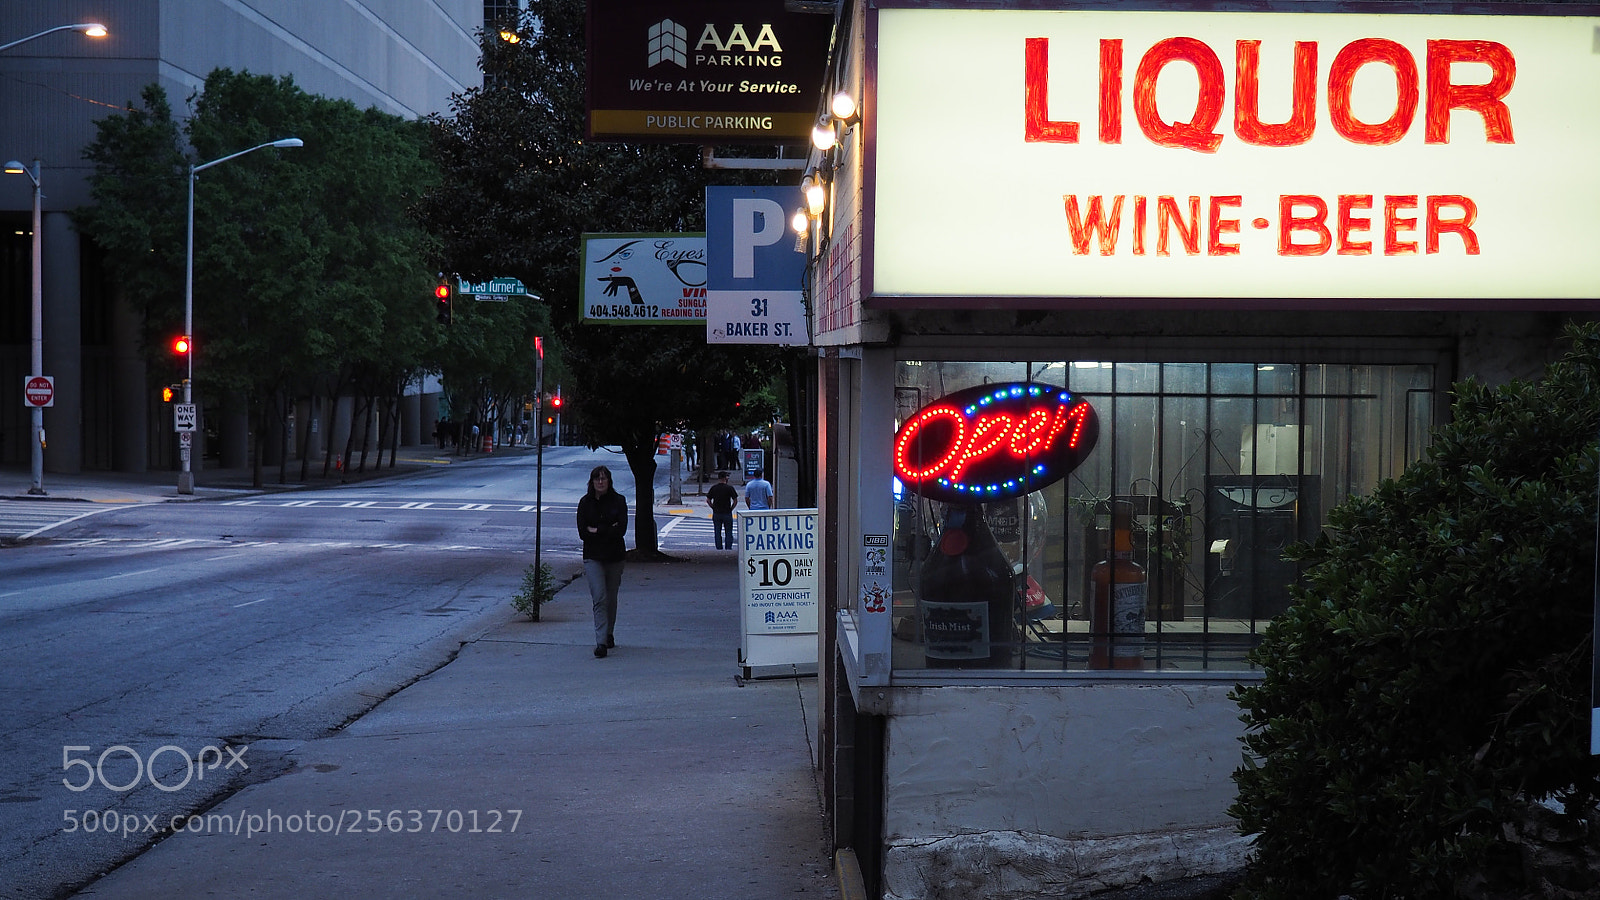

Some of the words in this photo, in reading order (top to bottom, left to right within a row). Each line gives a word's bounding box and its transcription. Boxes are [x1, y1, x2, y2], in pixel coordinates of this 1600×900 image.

[695, 23, 783, 52] AAA
[695, 55, 783, 67] PARKING
[629, 78, 673, 92] We're
[677, 79, 695, 92] At
[699, 80, 734, 93] Your
[738, 80, 802, 94] Service.
[1024, 36, 1517, 154] LIQUOR
[646, 115, 701, 129] PUBLIC
[705, 116, 773, 130] PARKING
[733, 198, 785, 278] P
[653, 240, 704, 266] Eyes
[489, 280, 516, 293] Turner
[589, 304, 658, 318] 404.548.4612
[661, 308, 692, 318] READING
[751, 299, 768, 317] 31
[726, 322, 768, 337] BAKER
[774, 323, 793, 337] ST.
[896, 400, 1090, 481] Open
[745, 515, 814, 532] PUBLIC
[745, 532, 814, 550] PARKING
[794, 559, 814, 567] DAILY
[747, 557, 792, 587] $10
[794, 568, 812, 577] RATE
[751, 593, 765, 601] $20
[766, 592, 811, 600] OVERNIGHT
[776, 611, 799, 619] AAA
[929, 620, 948, 631] Irish
[949, 622, 972, 632] Mist
